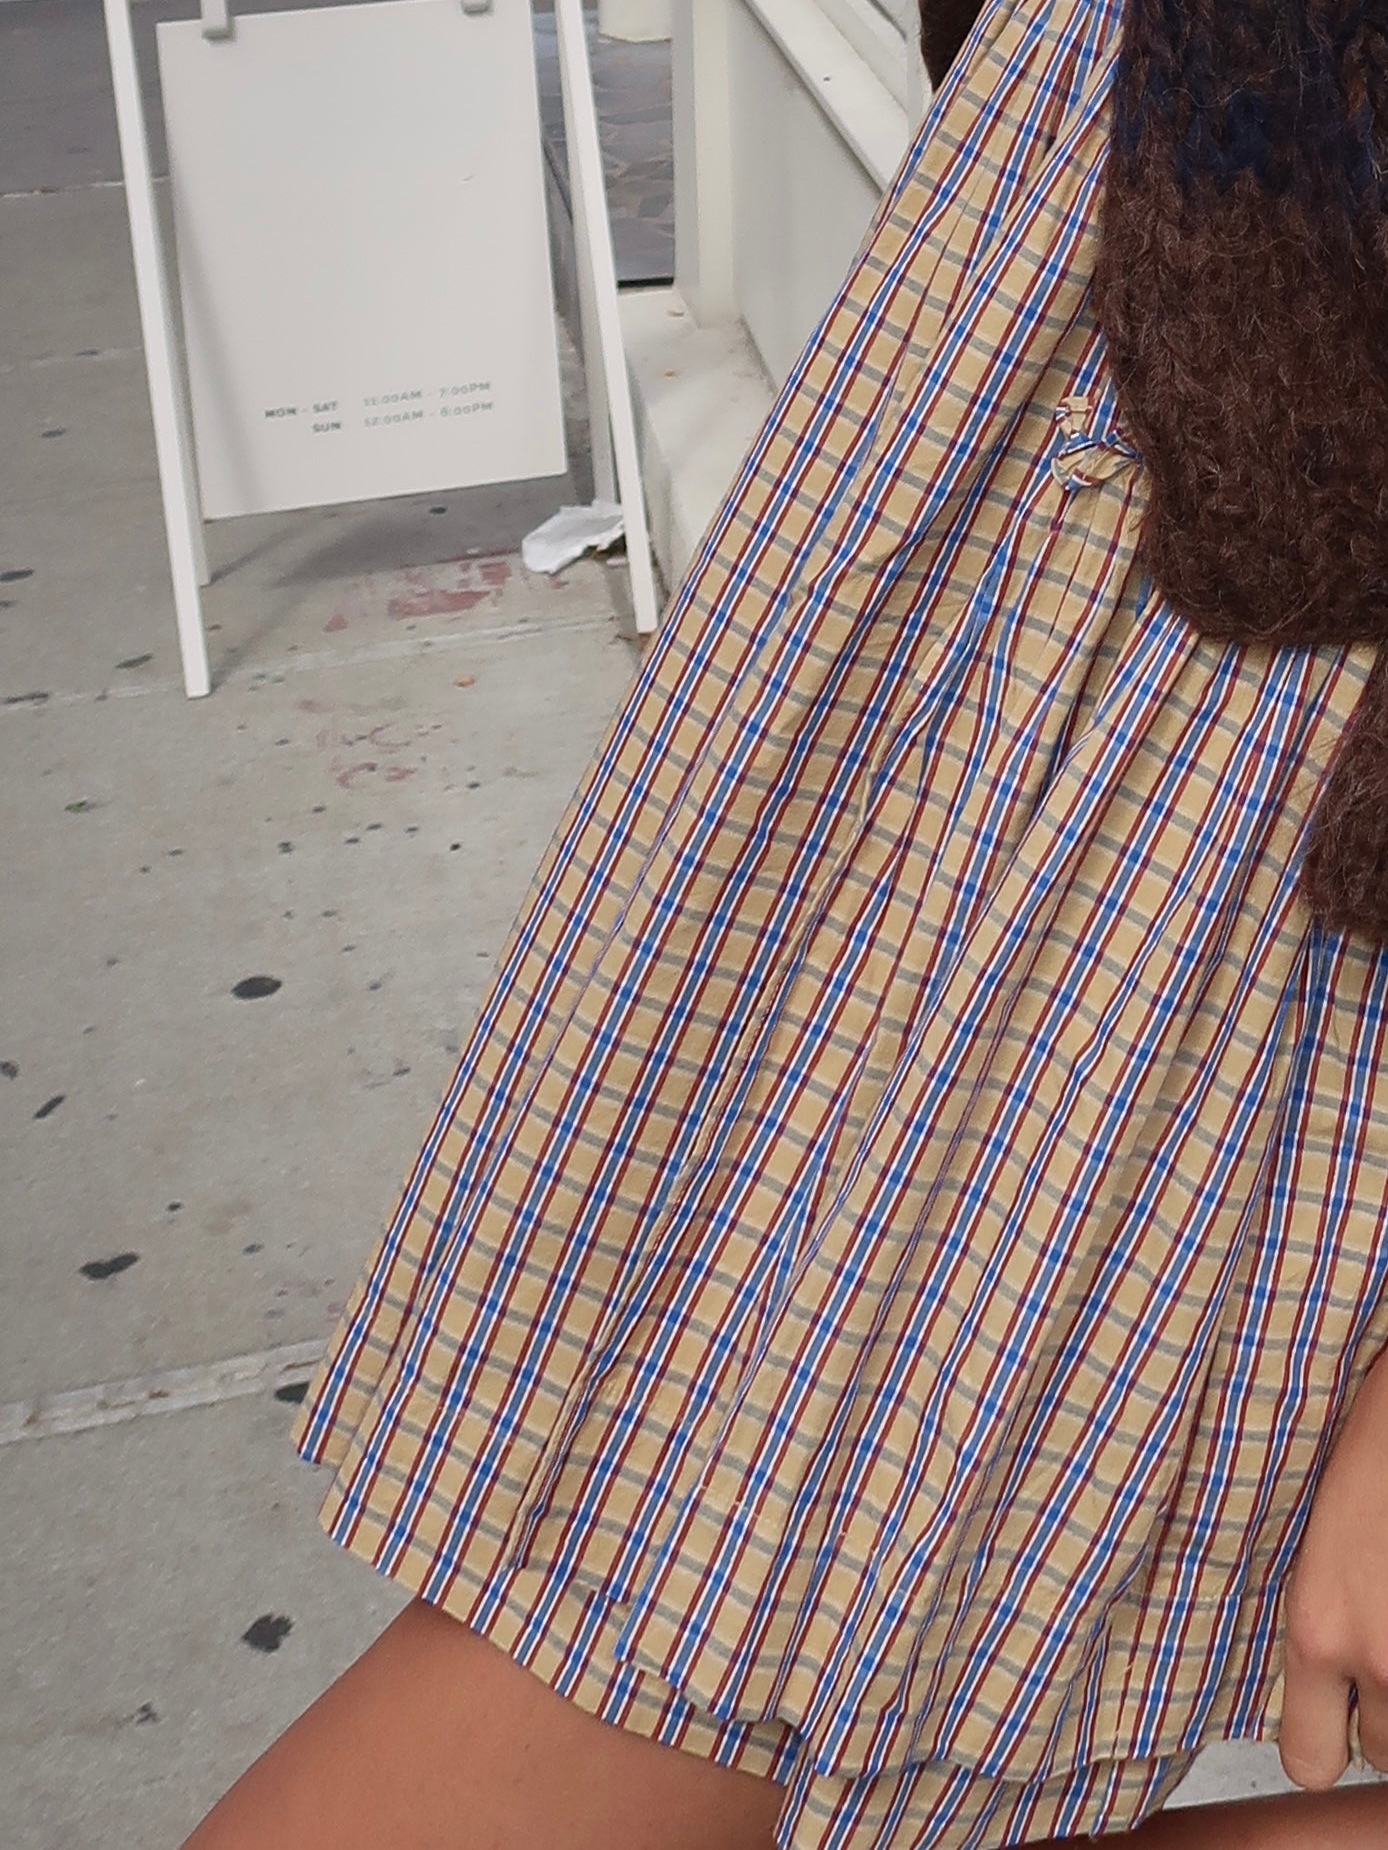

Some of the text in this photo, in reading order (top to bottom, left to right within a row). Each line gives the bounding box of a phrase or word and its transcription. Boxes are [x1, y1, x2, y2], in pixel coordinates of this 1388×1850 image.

[264, 407, 297, 418] MON
[312, 400, 338, 413] SAT
[312, 421, 342, 433] SUN
